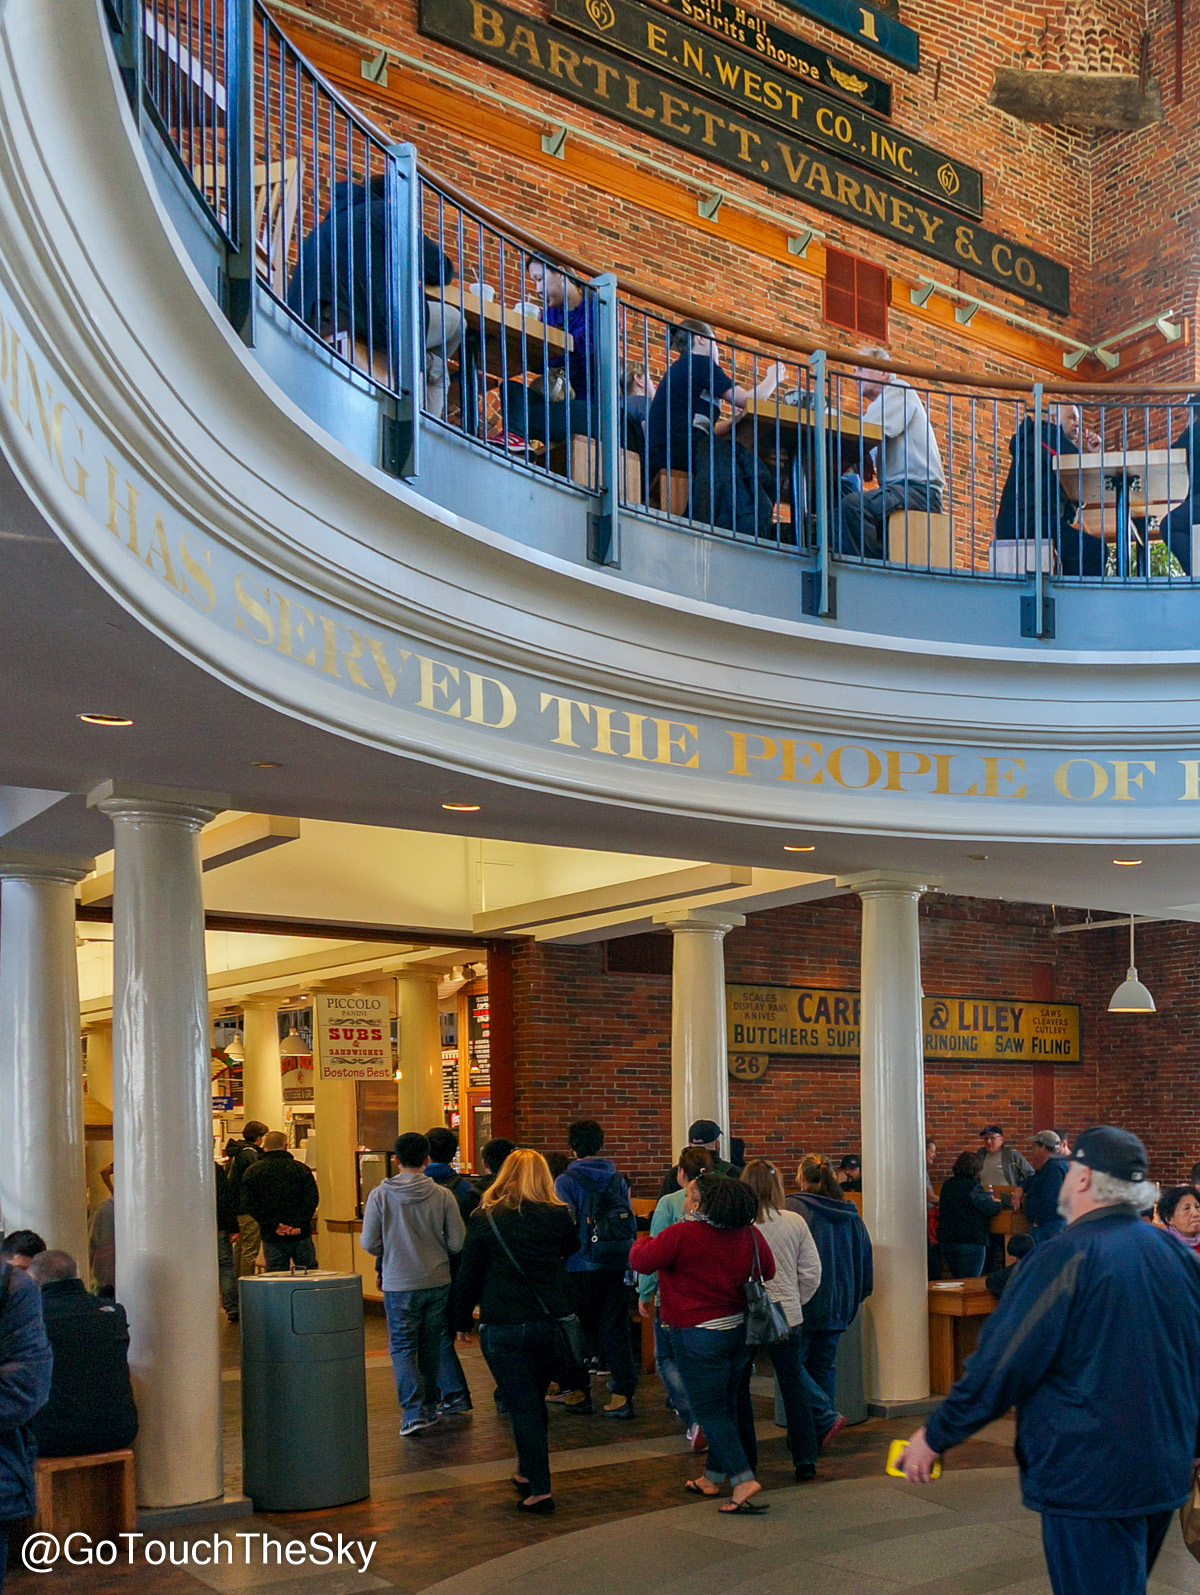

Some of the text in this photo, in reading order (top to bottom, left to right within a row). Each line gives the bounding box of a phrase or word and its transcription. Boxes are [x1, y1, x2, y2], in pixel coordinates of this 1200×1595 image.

[591, 4, 608, 26] 65
[735, 7, 767, 35] Hall
[859, 8, 879, 42] 1
[682, 0, 820, 79] Spirits Shoppe
[470, 0, 1044, 292] BARTLETT, VARNEY & CO.
[941, 169, 955, 188] 67
[0, 312, 89, 504] ING
[104, 453, 215, 611] HAS
[234, 572, 517, 729] SERVED
[539, 692, 699, 768] THE
[726, 729, 1027, 798] PEOPLE
[1054, 758, 1156, 800] OF
[326, 998, 381, 1009] PICCOLO
[742, 992, 778, 1003] SCALES
[733, 1002, 788, 1012] DISPLAY PANS
[1040, 1009, 1062, 1017] SAWS
[744, 1012, 776, 1021] KNIVES
[929, 1001, 949, 1030] &
[958, 1001, 1024, 1034] LILEY
[1032, 1017, 1068, 1026] CLEAVERS
[328, 1028, 382, 1040] SUBS
[1035, 1026, 1067, 1034] CUTLERY
[734, 1024, 819, 1047] BUTCHERS
[925, 1034, 979, 1051] RINDING
[995, 1035, 1025, 1053] SAW
[1031, 1037, 1071, 1055] FILING
[323, 1067, 390, 1078] Bostons Best
[734, 1056, 760, 1074] 26
